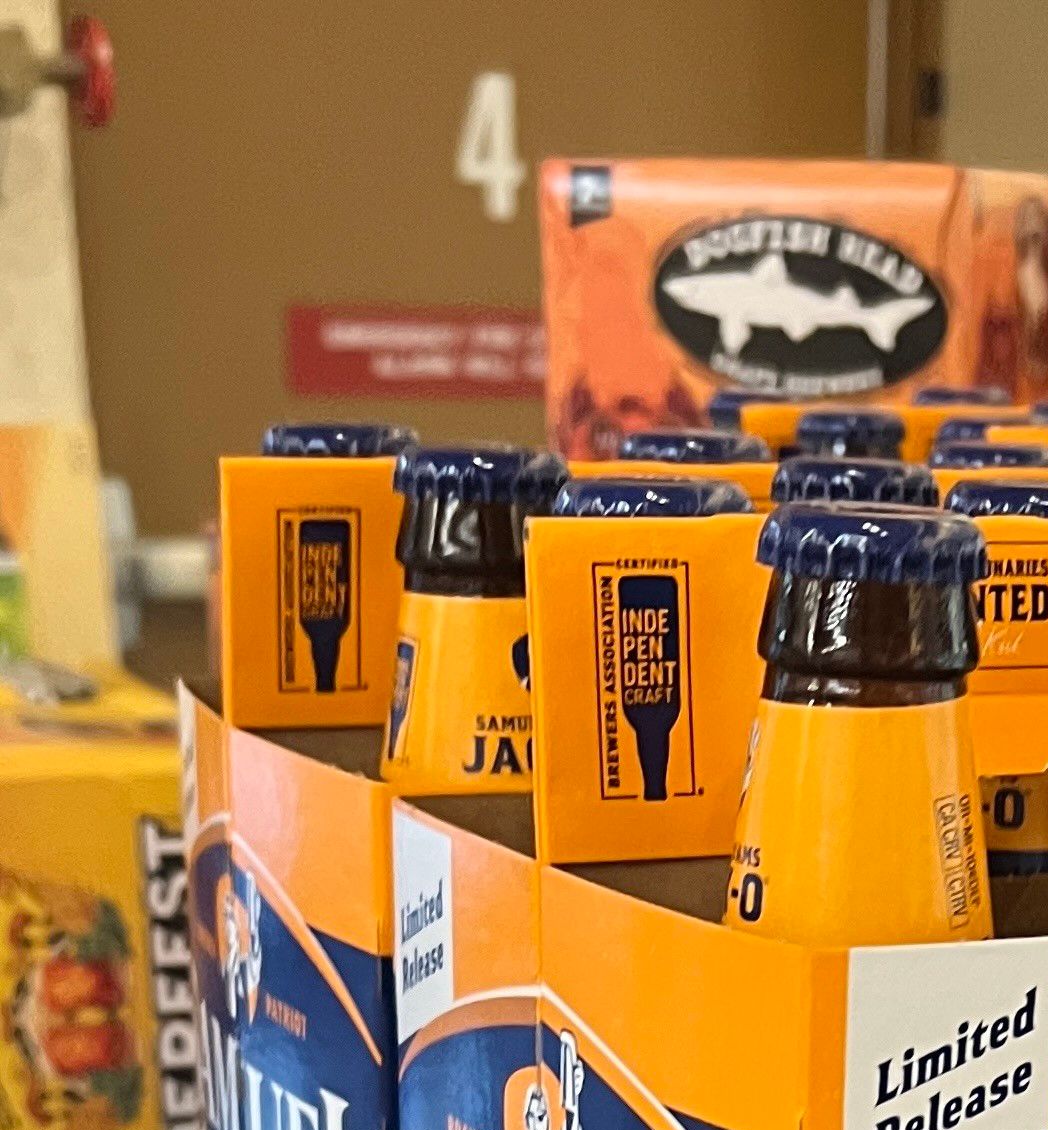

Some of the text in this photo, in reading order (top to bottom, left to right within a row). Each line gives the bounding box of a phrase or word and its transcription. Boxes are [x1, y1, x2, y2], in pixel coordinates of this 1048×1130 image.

[457, 72, 526, 221] 4
[622, 608, 669, 634] INDE
[623, 635, 664, 660] PEN
[600, 575, 621, 789] BREWERS ASSOCIATION
[623, 661, 677, 687] DENT
[624, 686, 674, 705] CRAFT
[401, 877, 444, 945] Limited
[402, 941, 445, 996] Release
[874, 985, 1038, 1109] Limited
